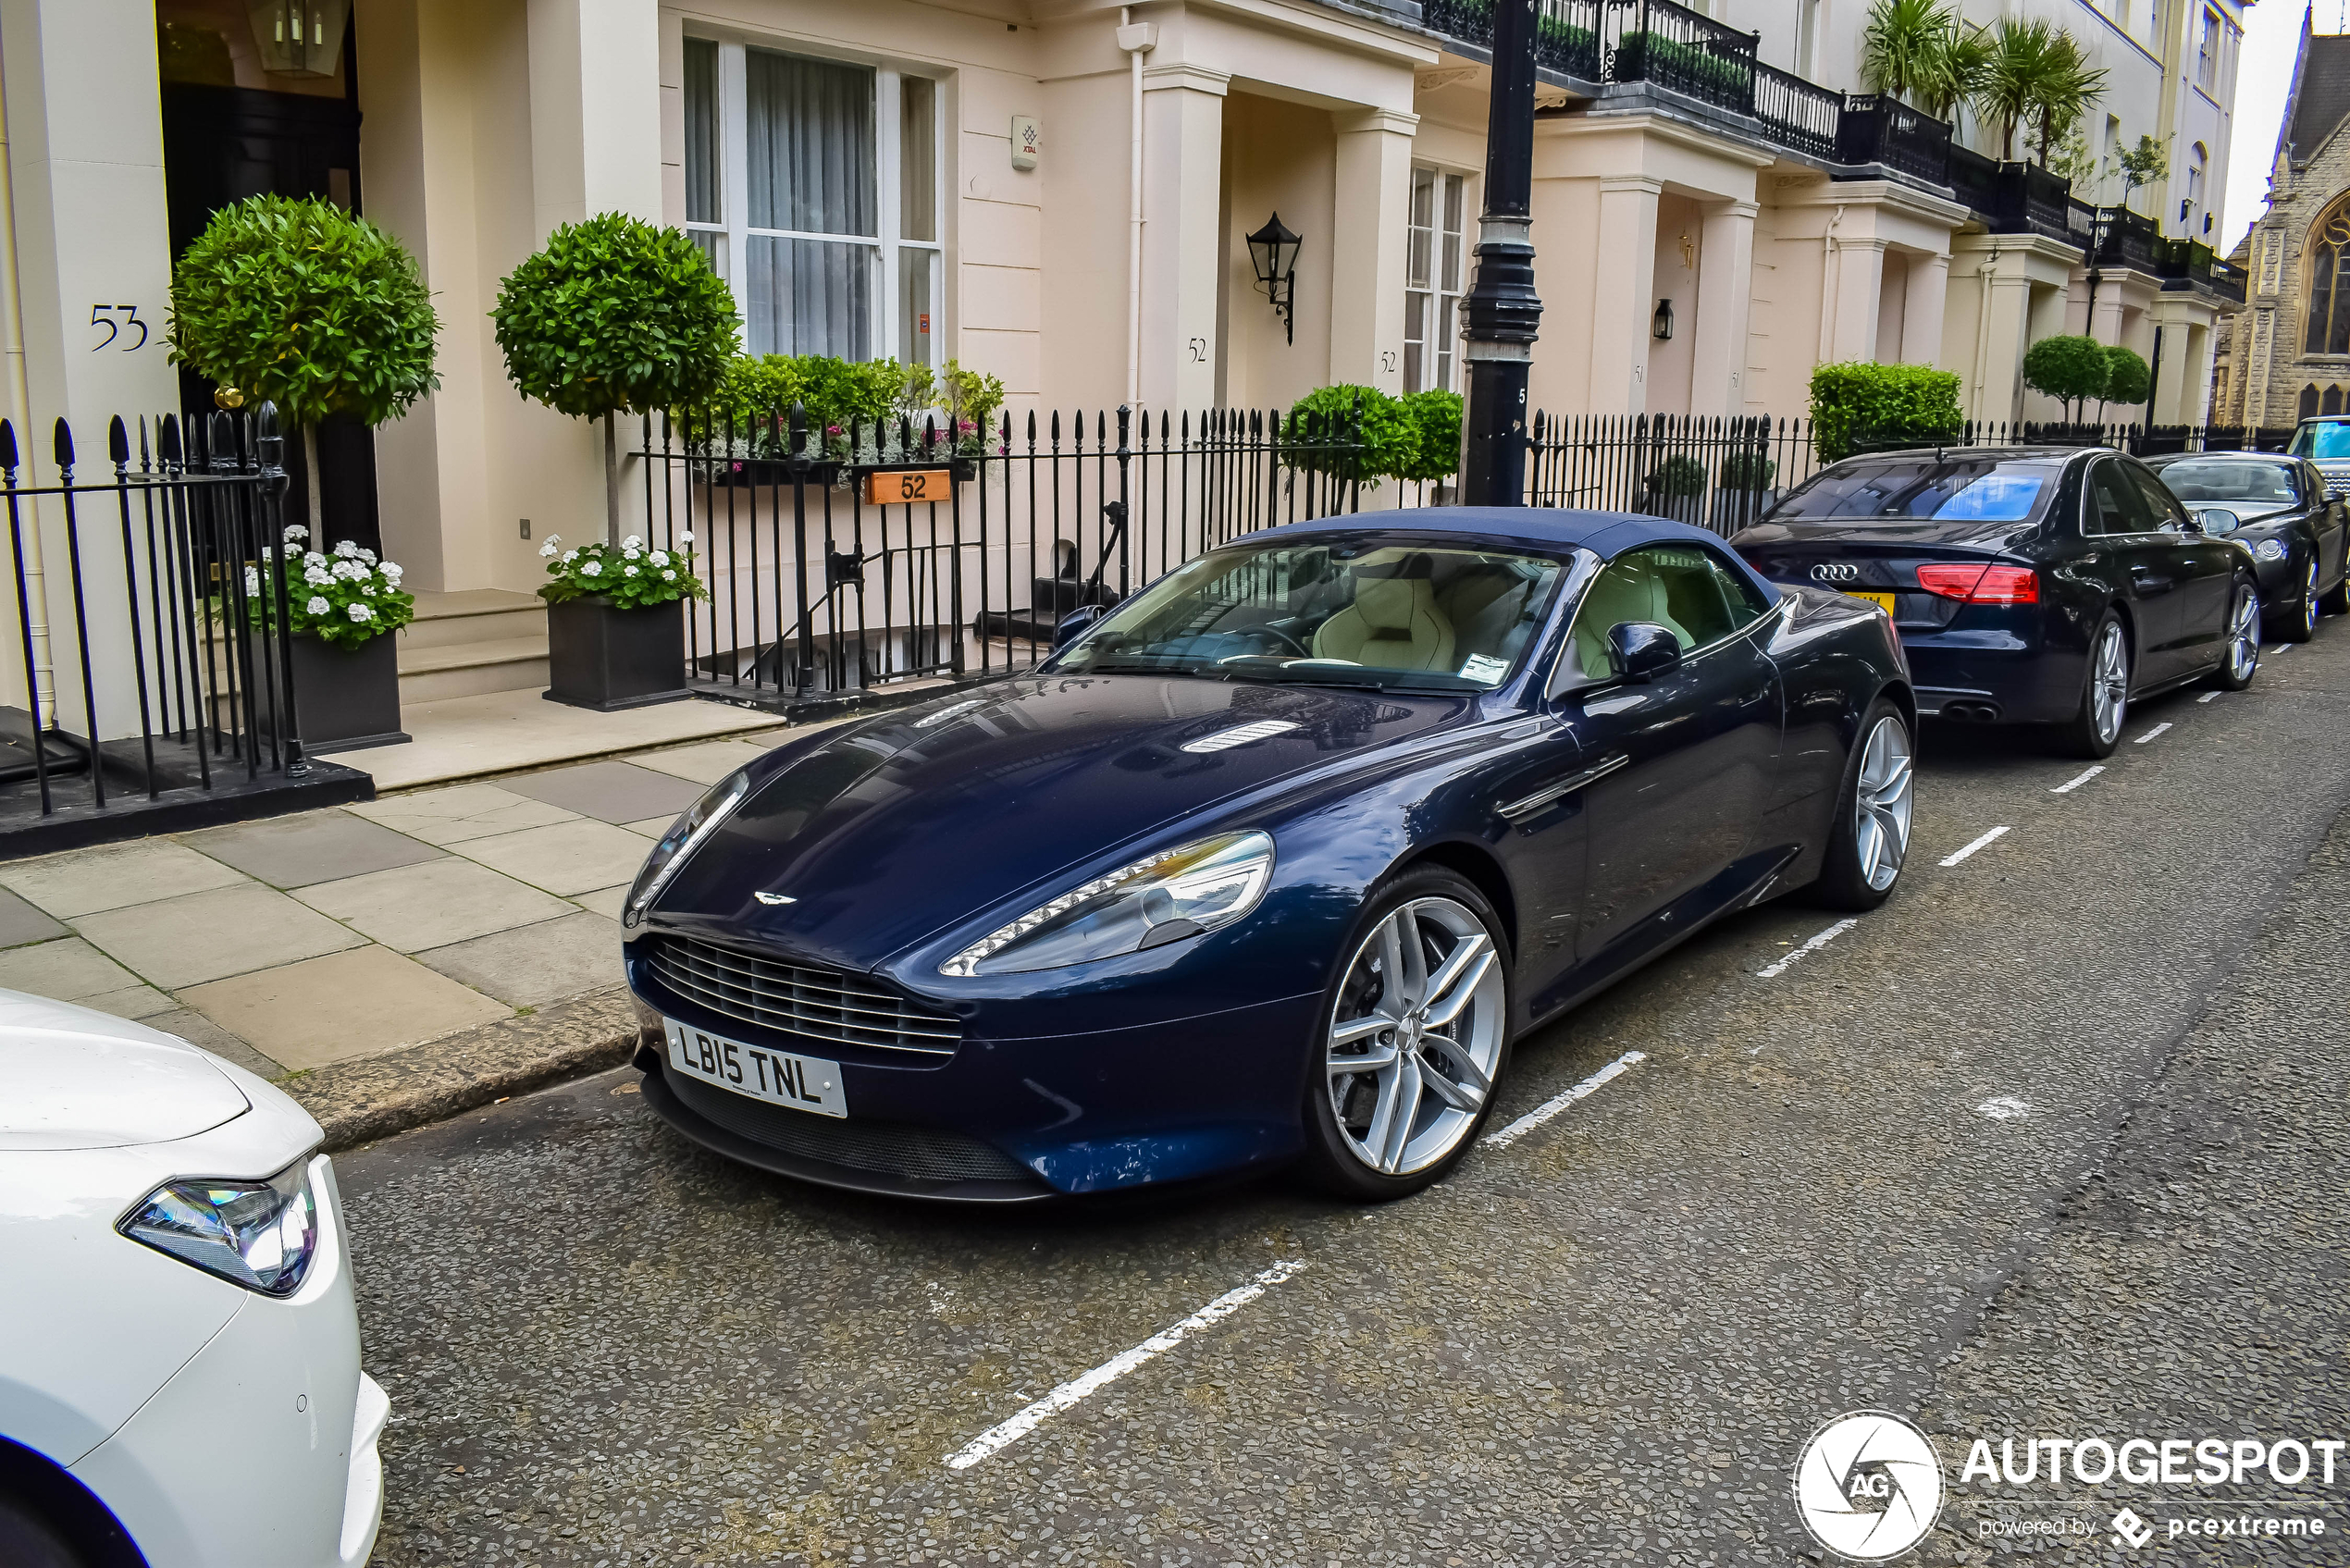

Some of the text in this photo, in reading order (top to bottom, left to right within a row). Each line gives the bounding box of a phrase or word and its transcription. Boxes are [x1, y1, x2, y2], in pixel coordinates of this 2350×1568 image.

[91, 304, 148, 352] 53
[1189, 338, 1206, 364] 52
[1381, 352, 1396, 374] 52
[1634, 365, 1643, 384] 51
[1732, 372, 1739, 389] 51
[1518, 389, 1526, 403] 5
[901, 475, 926, 500] 52
[678, 1027, 822, 1104] LB15 TNL
